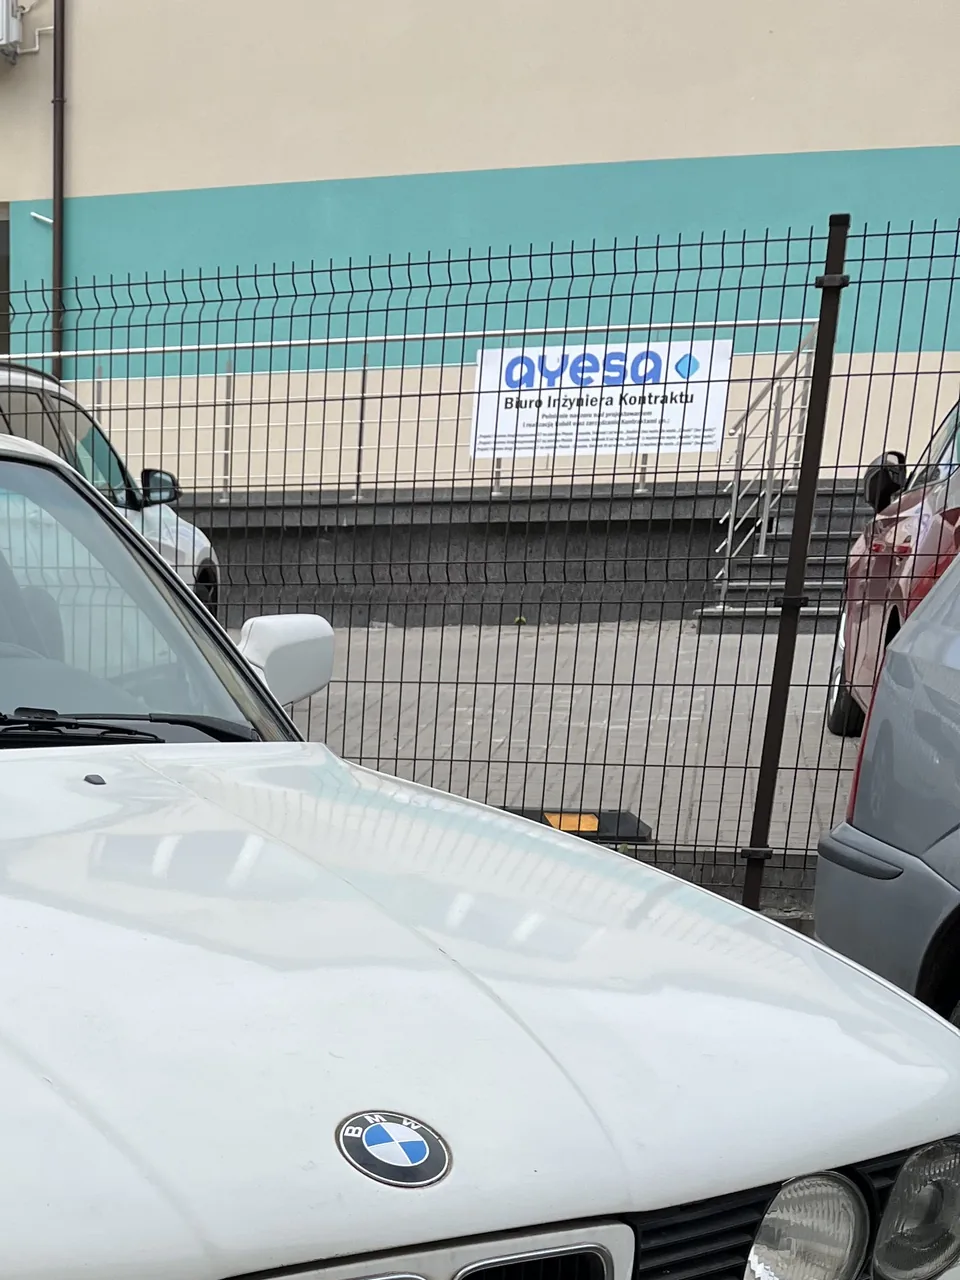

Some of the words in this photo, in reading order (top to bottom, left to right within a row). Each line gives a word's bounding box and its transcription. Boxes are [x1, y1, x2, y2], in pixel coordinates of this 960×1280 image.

[505, 351, 663, 389] ayesa
[504, 396, 543, 410] Biuro
[547, 393, 614, 412] Inżyniera
[619, 391, 695, 407] Kontraktu
[343, 1113, 422, 1138] BMW
